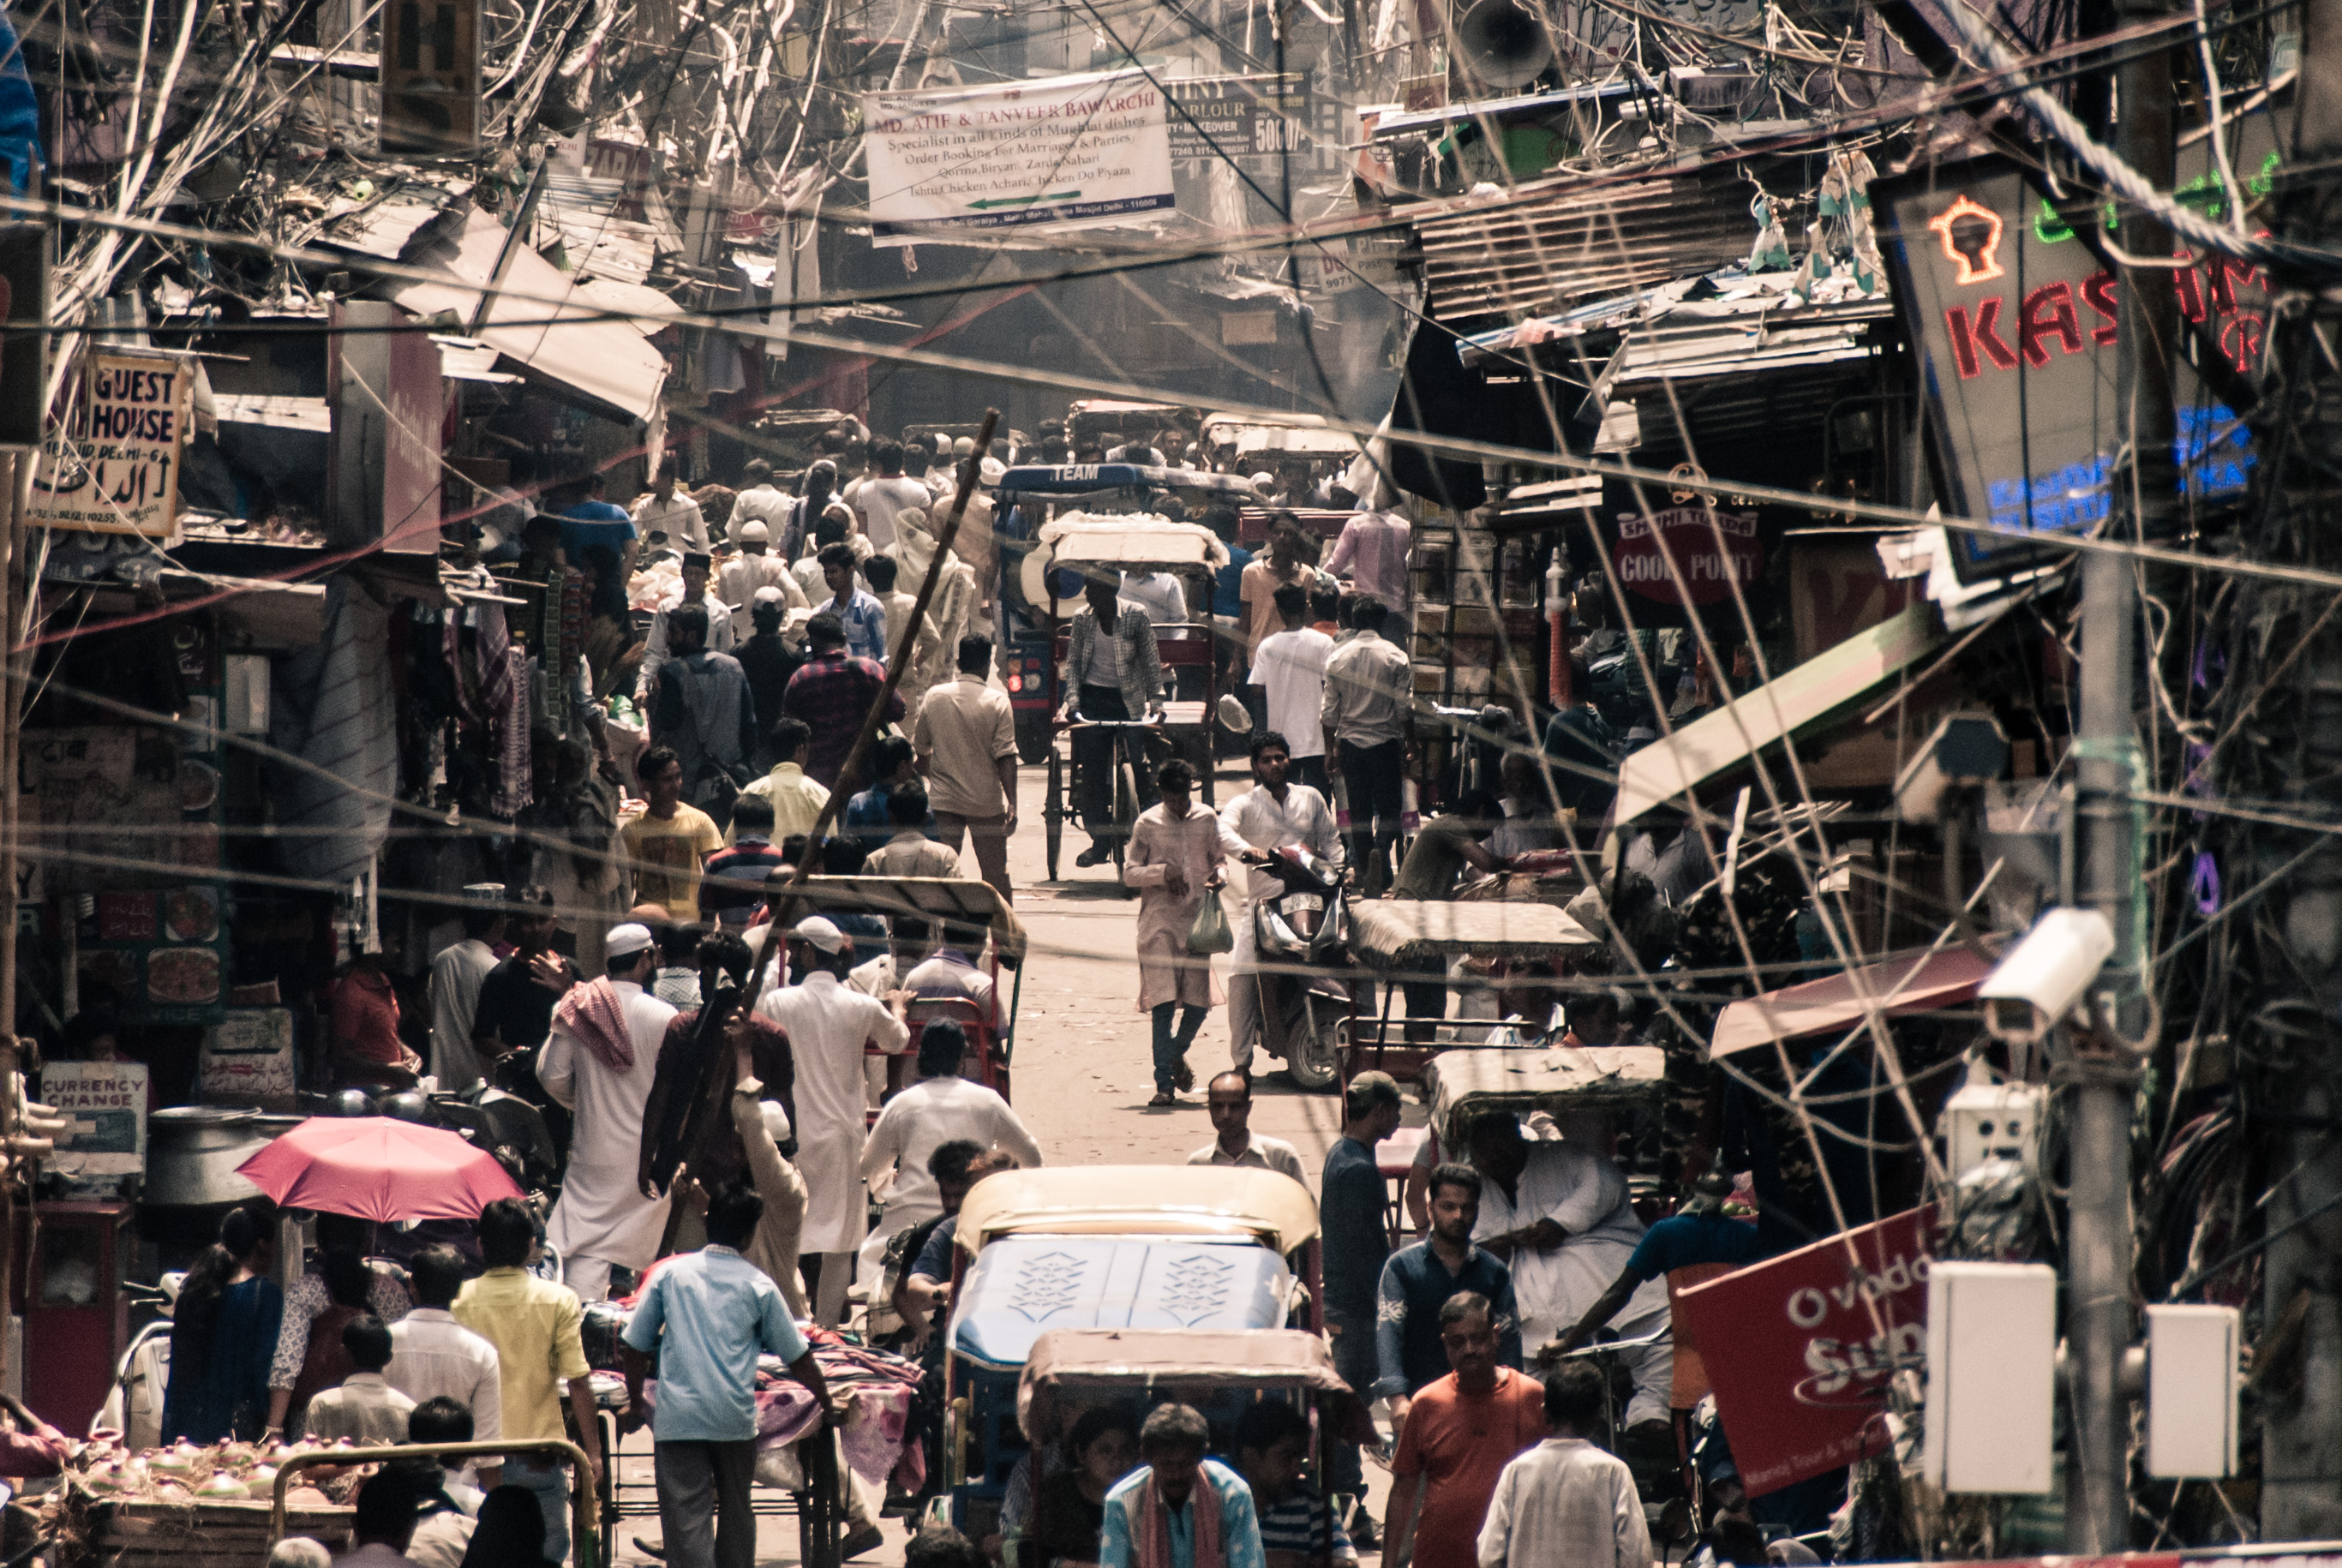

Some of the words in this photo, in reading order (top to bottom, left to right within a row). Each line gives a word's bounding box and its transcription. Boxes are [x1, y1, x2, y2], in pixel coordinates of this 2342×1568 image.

[875, 118, 907, 134] MD.
[913, 114, 950, 131] ATIF
[959, 114, 972, 127] &
[979, 105, 1060, 124] TANVEER
[1066, 92, 1156, 117] BAWARCHI
[888, 135, 949, 154] Specialist
[954, 133, 966, 144] in
[969, 131, 984, 142] all
[1030, 127, 1043, 138] of
[1105, 114, 1146, 131] dishes
[905, 153, 938, 165] Order
[943, 147, 991, 162] Booking
[1018, 140, 1076, 157] Marriages
[1080, 139, 1090, 148] &
[1078, 171, 1094, 181] Do
[1098, 166, 1132, 181] Piyaza
[1104, 201, 1123, 212] Delhi
[93, 368, 177, 404] GUEST
[92, 404, 175, 443] HOUSE
[1054, 464, 1100, 482] TEAM
[42, 1079, 145, 1093] CURRENCY
[47, 1093, 133, 1107] CHANGE
